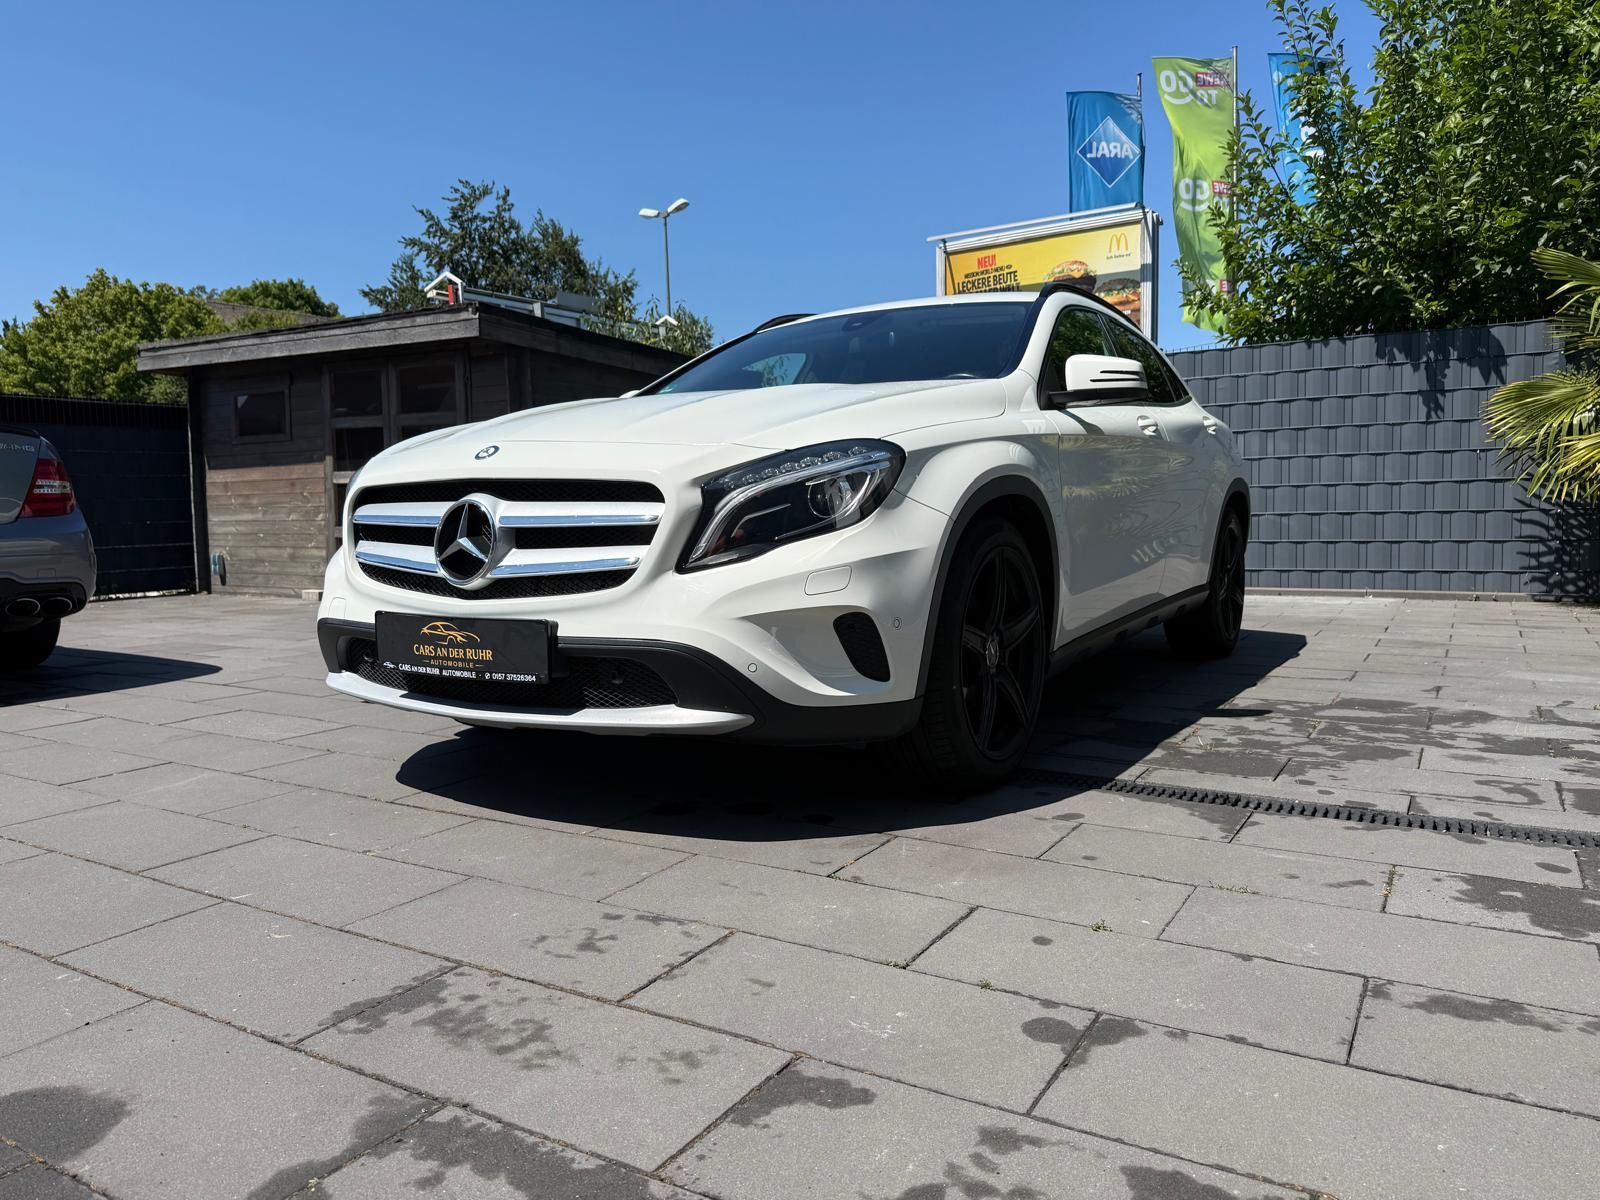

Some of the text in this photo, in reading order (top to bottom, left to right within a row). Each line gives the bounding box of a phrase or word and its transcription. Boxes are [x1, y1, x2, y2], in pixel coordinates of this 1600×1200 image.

[977, 254, 996, 269] NEU!
[957, 276, 992, 293] LECKERE
[993, 270, 1018, 286] BEUTE
[413, 643, 493, 661] CARS AN DER RUHR
[398, 663, 412, 672] CARS
[427, 666, 440, 675] RUHR
[442, 669, 477, 679] AUTOMOBILE
[430, 659, 474, 669] AUTOMOBILE
